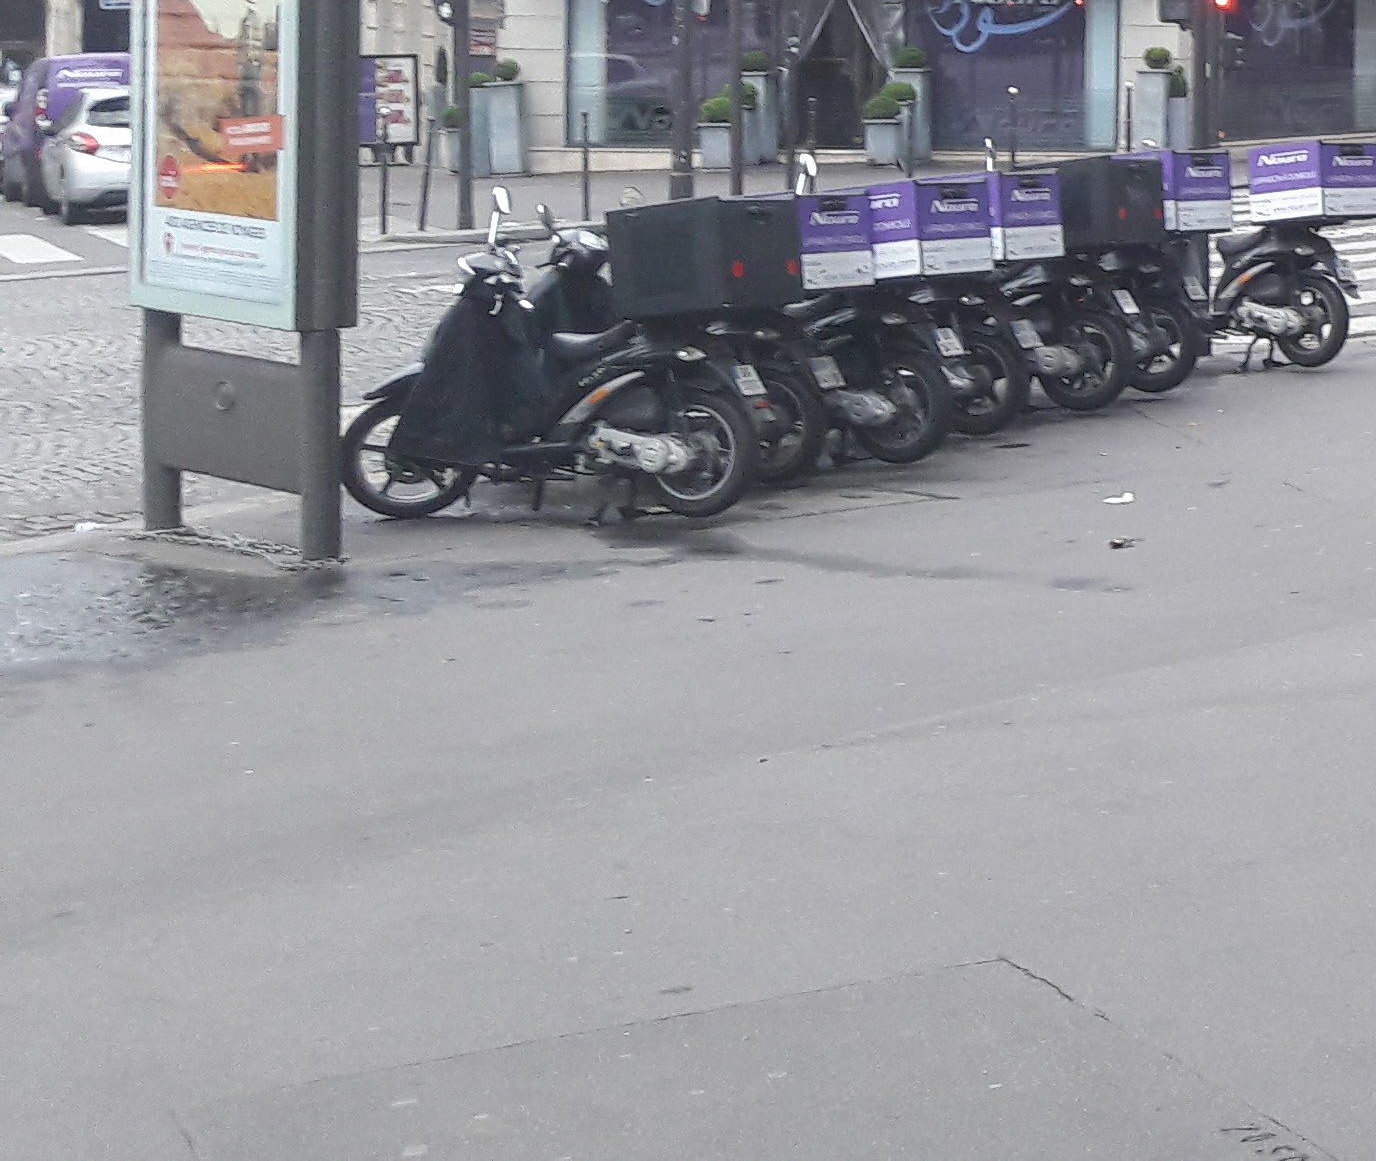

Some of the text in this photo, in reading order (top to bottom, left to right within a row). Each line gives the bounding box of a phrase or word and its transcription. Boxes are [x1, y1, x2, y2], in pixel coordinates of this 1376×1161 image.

[1257, 149, 1309, 167] Noura
[930, 197, 979, 213] Noura
[809, 209, 860, 226] Noura
